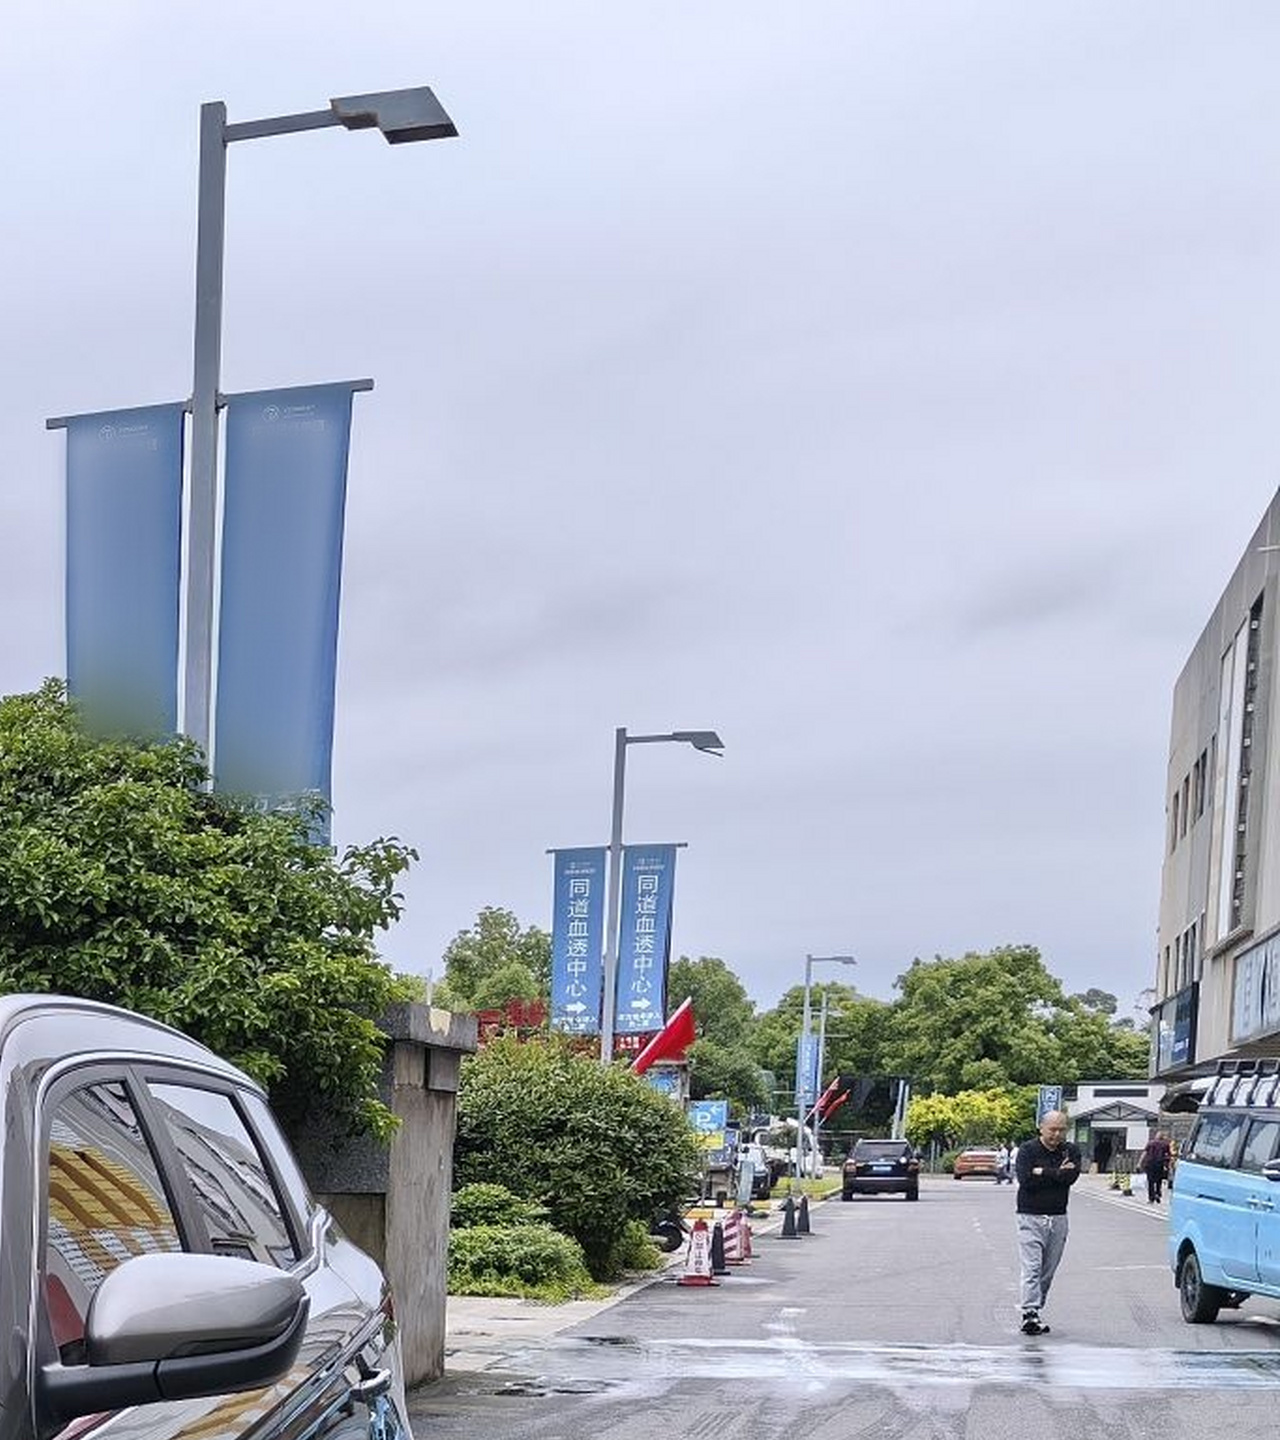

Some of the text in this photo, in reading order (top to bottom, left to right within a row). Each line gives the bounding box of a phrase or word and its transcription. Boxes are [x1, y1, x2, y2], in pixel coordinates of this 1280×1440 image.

[565, 878, 590, 997] 同道血透中心
[630, 874, 659, 994] 同道血透中心
